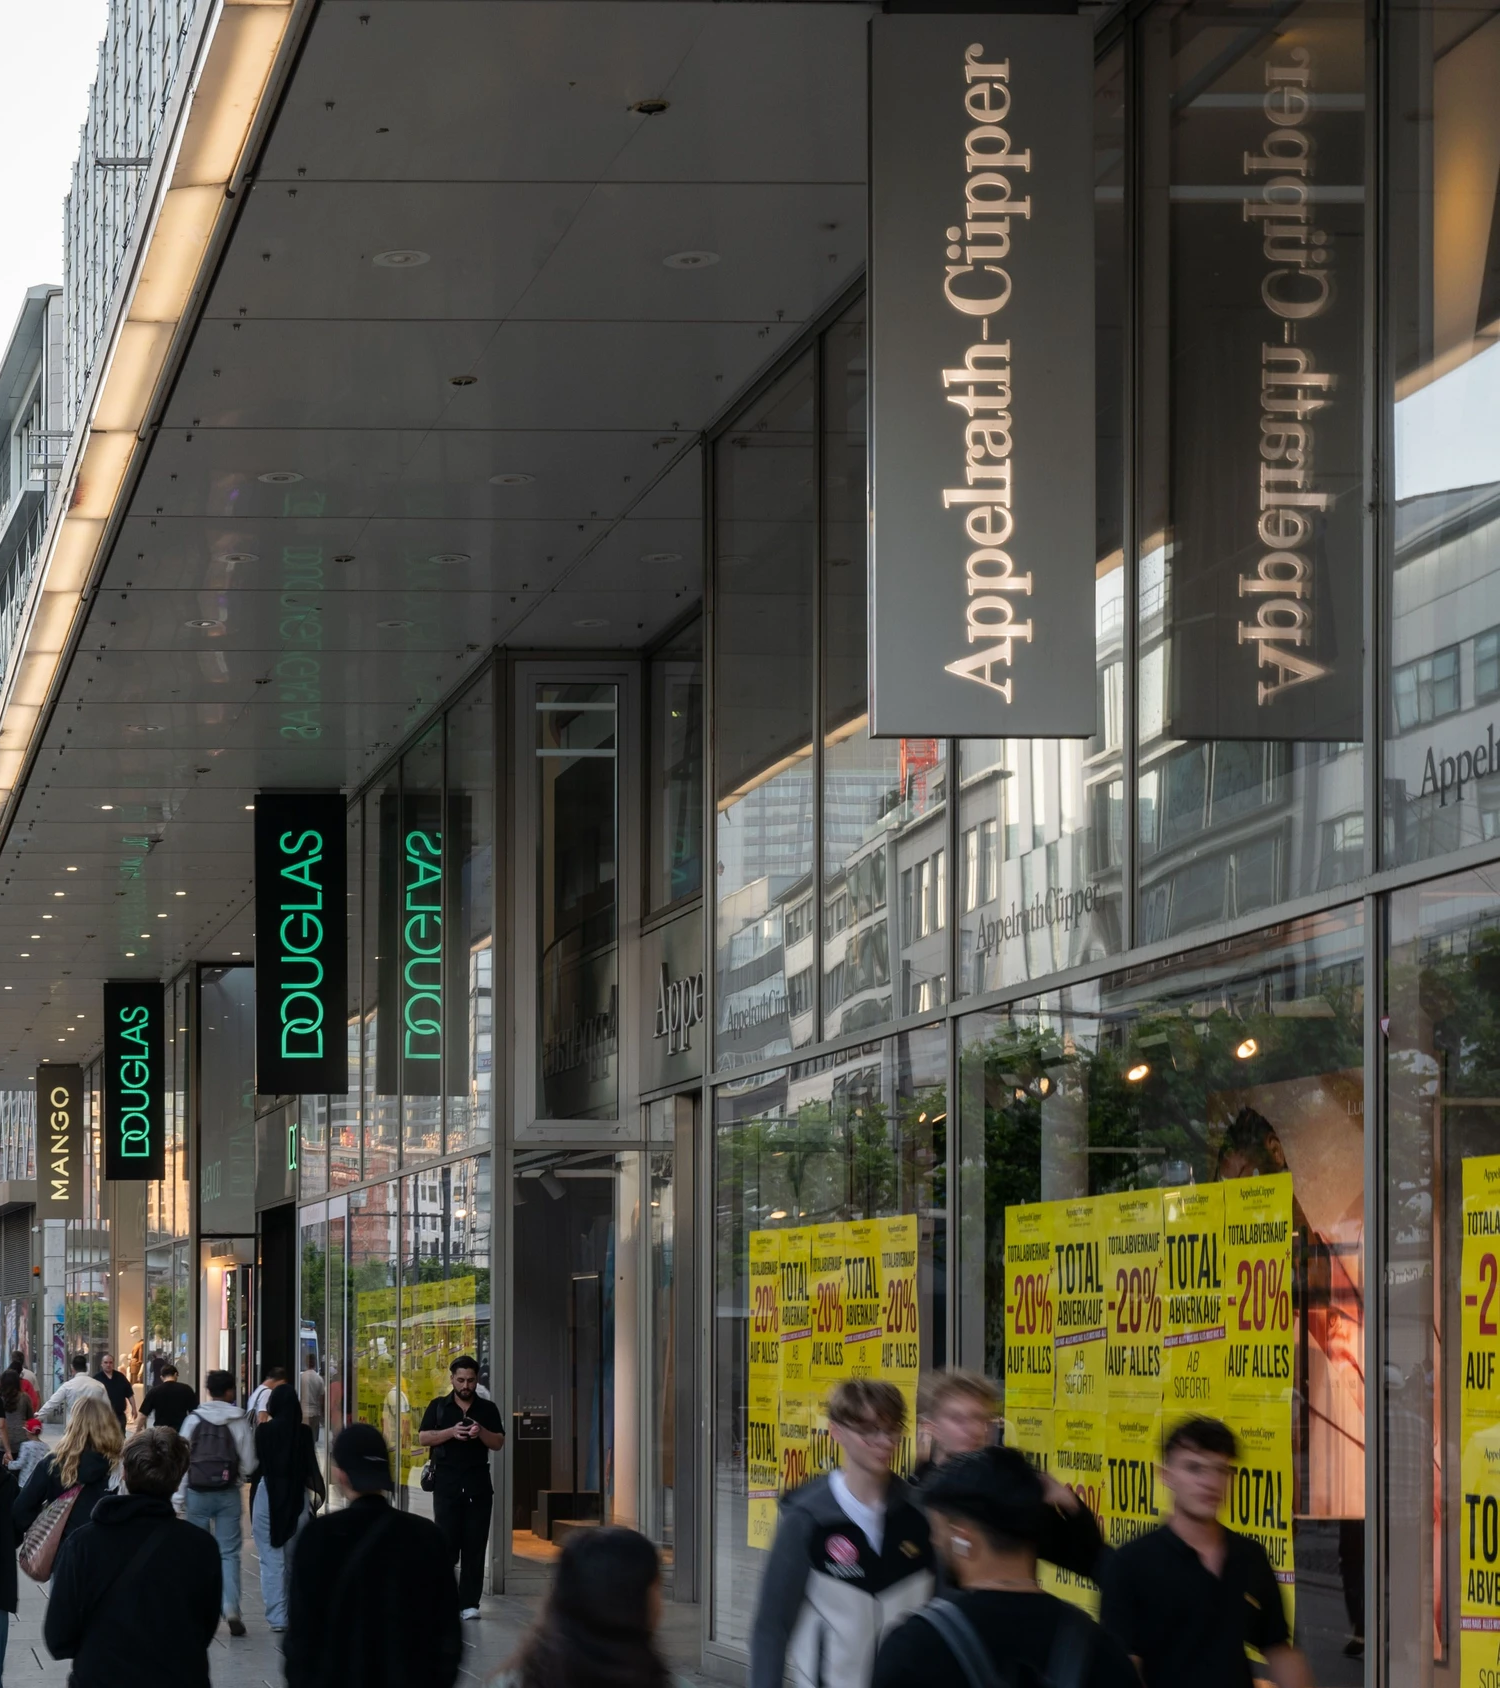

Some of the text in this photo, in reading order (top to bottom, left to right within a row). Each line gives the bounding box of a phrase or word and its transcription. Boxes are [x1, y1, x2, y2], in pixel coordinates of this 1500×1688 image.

[942, 42, 1032, 704] Appelrath-Cüpper
[280, 829, 324, 1060] DOUGLAS
[119, 1005, 150, 1158] DOUGLAS
[50, 1086, 70, 1201] MANGO
[1107, 1232, 1160, 1256] TOTALABVERKAUF
[1227, 1221, 1288, 1246] TOTALABVERKAUF
[1008, 1242, 1051, 1263] TOTALABVERKAUF
[1055, 1241, 1104, 1295] TOTAL
[1166, 1232, 1222, 1290] TOTAL
[780, 1261, 810, 1301] TOTAL
[845, 1256, 879, 1300] TOTAL
[846, 1304, 879, 1326] ABVERKAUF
[1057, 1299, 1104, 1327] ABVERKAUF
[1168, 1295, 1222, 1325] ABVERKAUF
[750, 1341, 779, 1364] AUF ALLES
[812, 1343, 844, 1366] AUF ALLES
[881, 1343, 917, 1369] AUF ALLES
[1007, 1346, 1051, 1374] AUF ALLES
[1073, 1350, 1085, 1370] AB
[1107, 1345, 1160, 1377] AUF ALLES
[1186, 1351, 1200, 1373] AB
[1227, 1344, 1290, 1379] AUF ALLES
[1065, 1373, 1095, 1395] SOFORT!
[1466, 1352, 1496, 1390] AUF
[1173, 1376, 1210, 1400] SOFORT!
[750, 1422, 777, 1462] TOTAL
[1108, 1458, 1159, 1516] TOTAL
[1227, 1465, 1288, 1531] TOTAL
[1465, 1494, 1499, 1565] TO
